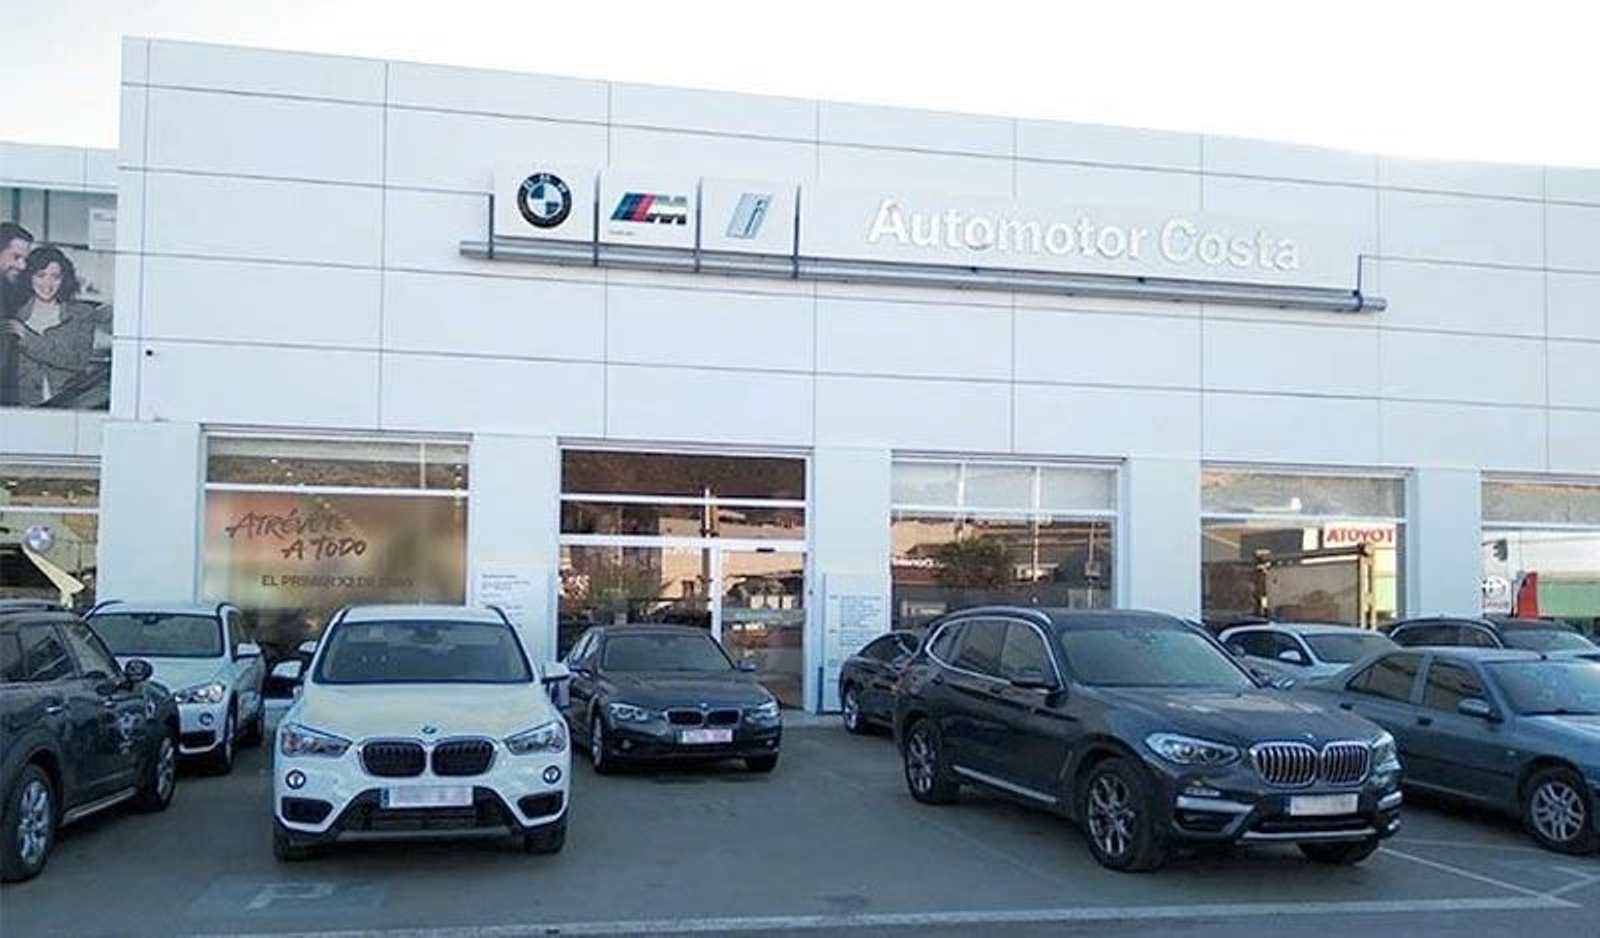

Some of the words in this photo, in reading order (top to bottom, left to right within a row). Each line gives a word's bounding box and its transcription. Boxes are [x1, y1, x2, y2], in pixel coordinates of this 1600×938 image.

[866, 198, 1148, 259] Automotor
[1160, 217, 1303, 271] Costa
[281, 539, 304, 560] A
[311, 536, 367, 560] TODO
[262, 574, 278, 587] EL
